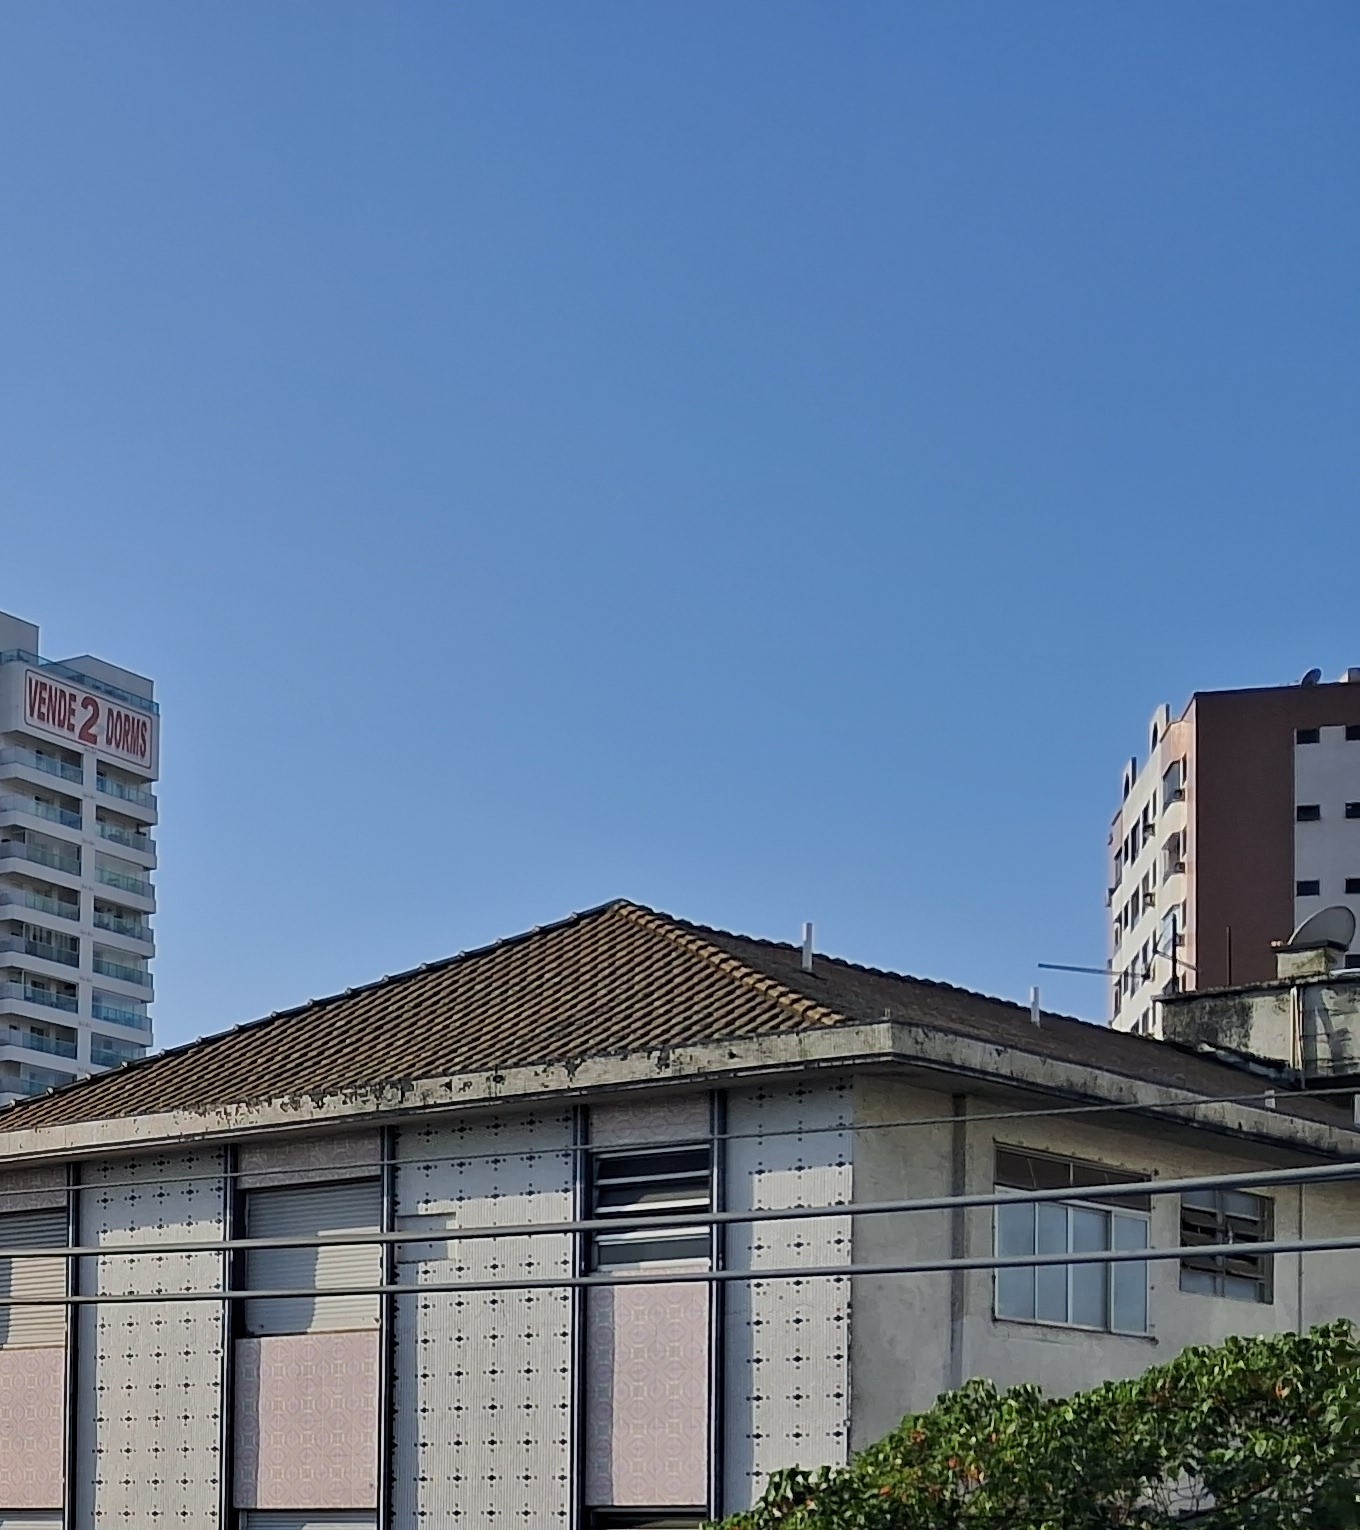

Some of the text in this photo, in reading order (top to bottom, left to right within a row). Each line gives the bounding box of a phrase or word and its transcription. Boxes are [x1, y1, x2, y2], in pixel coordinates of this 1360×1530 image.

[28, 677, 148, 758] VENDE 2 DORMS
